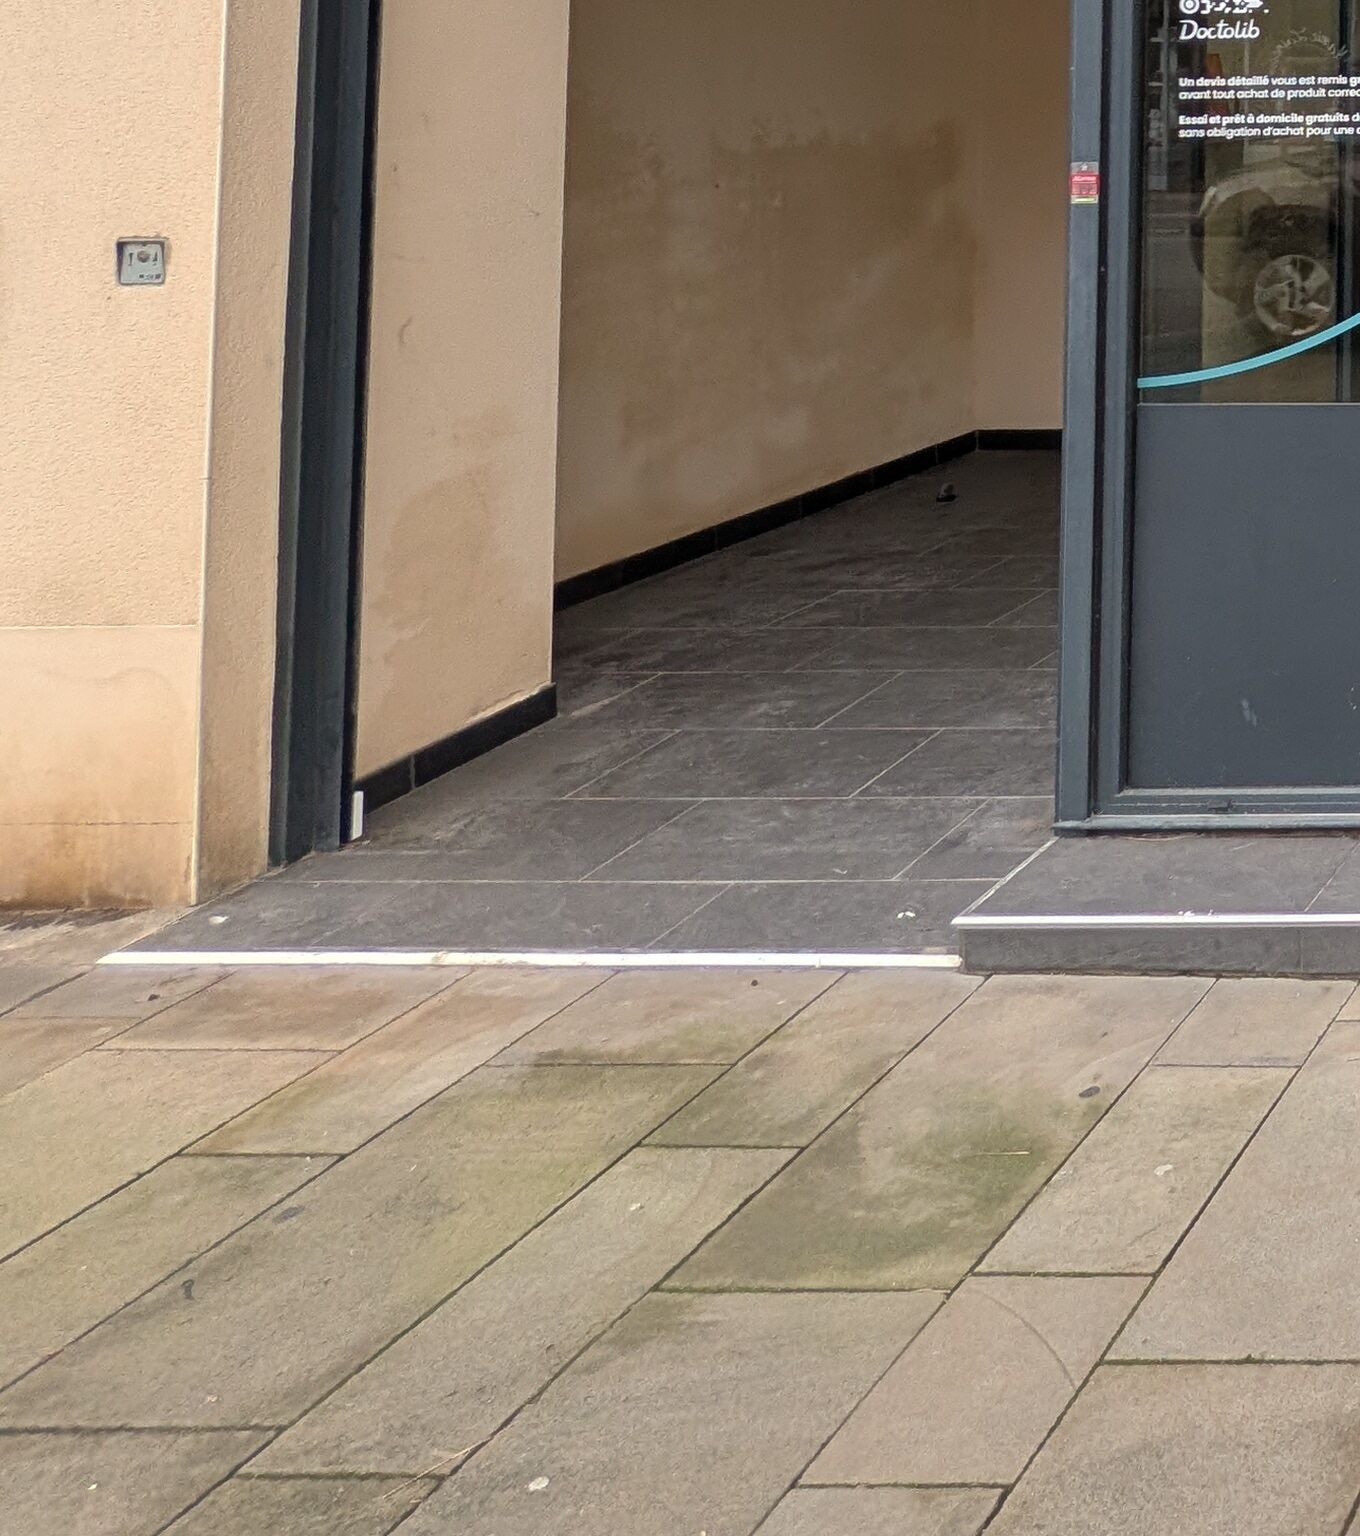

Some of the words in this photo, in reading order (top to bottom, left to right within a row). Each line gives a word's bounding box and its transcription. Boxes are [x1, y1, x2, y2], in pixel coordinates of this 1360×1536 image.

[1179, 19, 1260, 40] Doctolib
[1179, 77, 1195, 87] Un
[1196, 76, 1226, 87] devis
[1227, 75, 1269, 86] détaillé
[1271, 76, 1297, 86] vous
[1298, 76, 1316, 86] est
[1317, 75, 1347, 85] remis
[1179, 90, 1212, 100] avant
[1212, 89, 1236, 99] tout
[1237, 89, 1269, 99] achat
[1270, 88, 1286, 98] de
[1287, 88, 1326, 101] produit
[1179, 114, 1208, 125] Essai
[1209, 114, 1222, 125] et
[1256, 113, 1304, 124] domicile
[1305, 112, 1350, 125] gratuits
[1178, 128, 1205, 138] sans
[1206, 127, 1261, 139] obligation
[1306, 126, 1332, 138] pour
[1333, 126, 1354, 135] une
